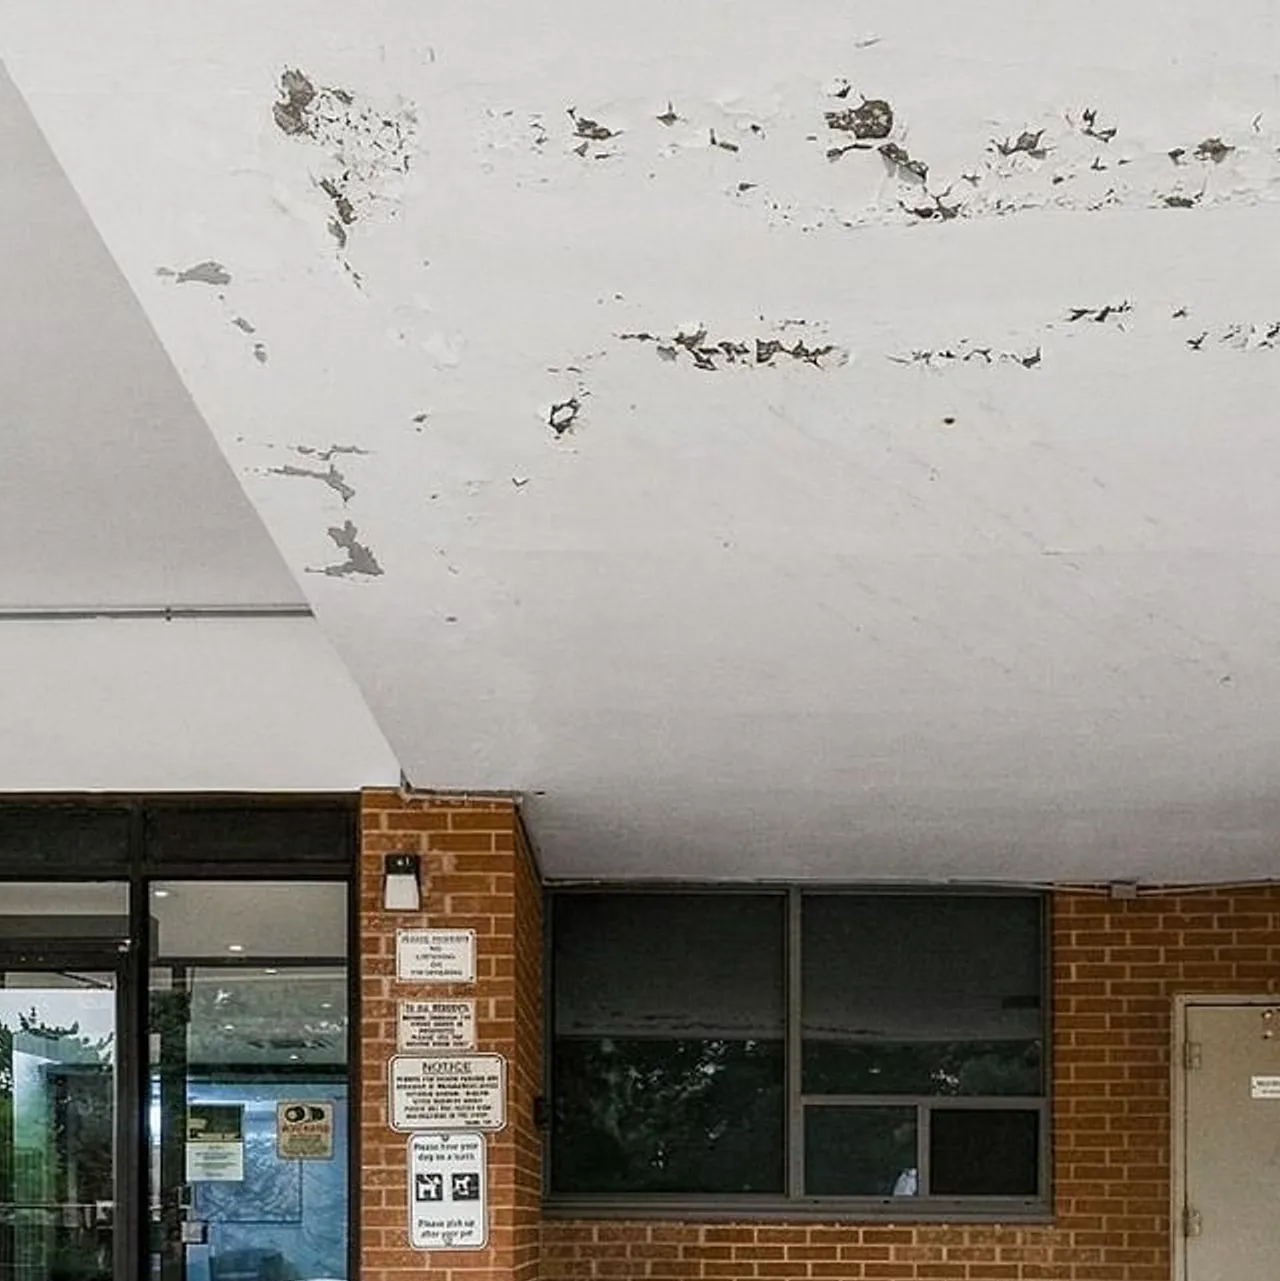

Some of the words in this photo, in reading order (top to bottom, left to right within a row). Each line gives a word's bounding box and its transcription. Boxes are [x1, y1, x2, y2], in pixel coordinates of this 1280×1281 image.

[422, 1062, 472, 1073] NOTICE
[418, 1153, 433, 1162] dog
[418, 1219, 444, 1227] Please
[446, 1219, 462, 1228] pick
[421, 1230, 439, 1238] after
[460, 1230, 473, 1239] pet
